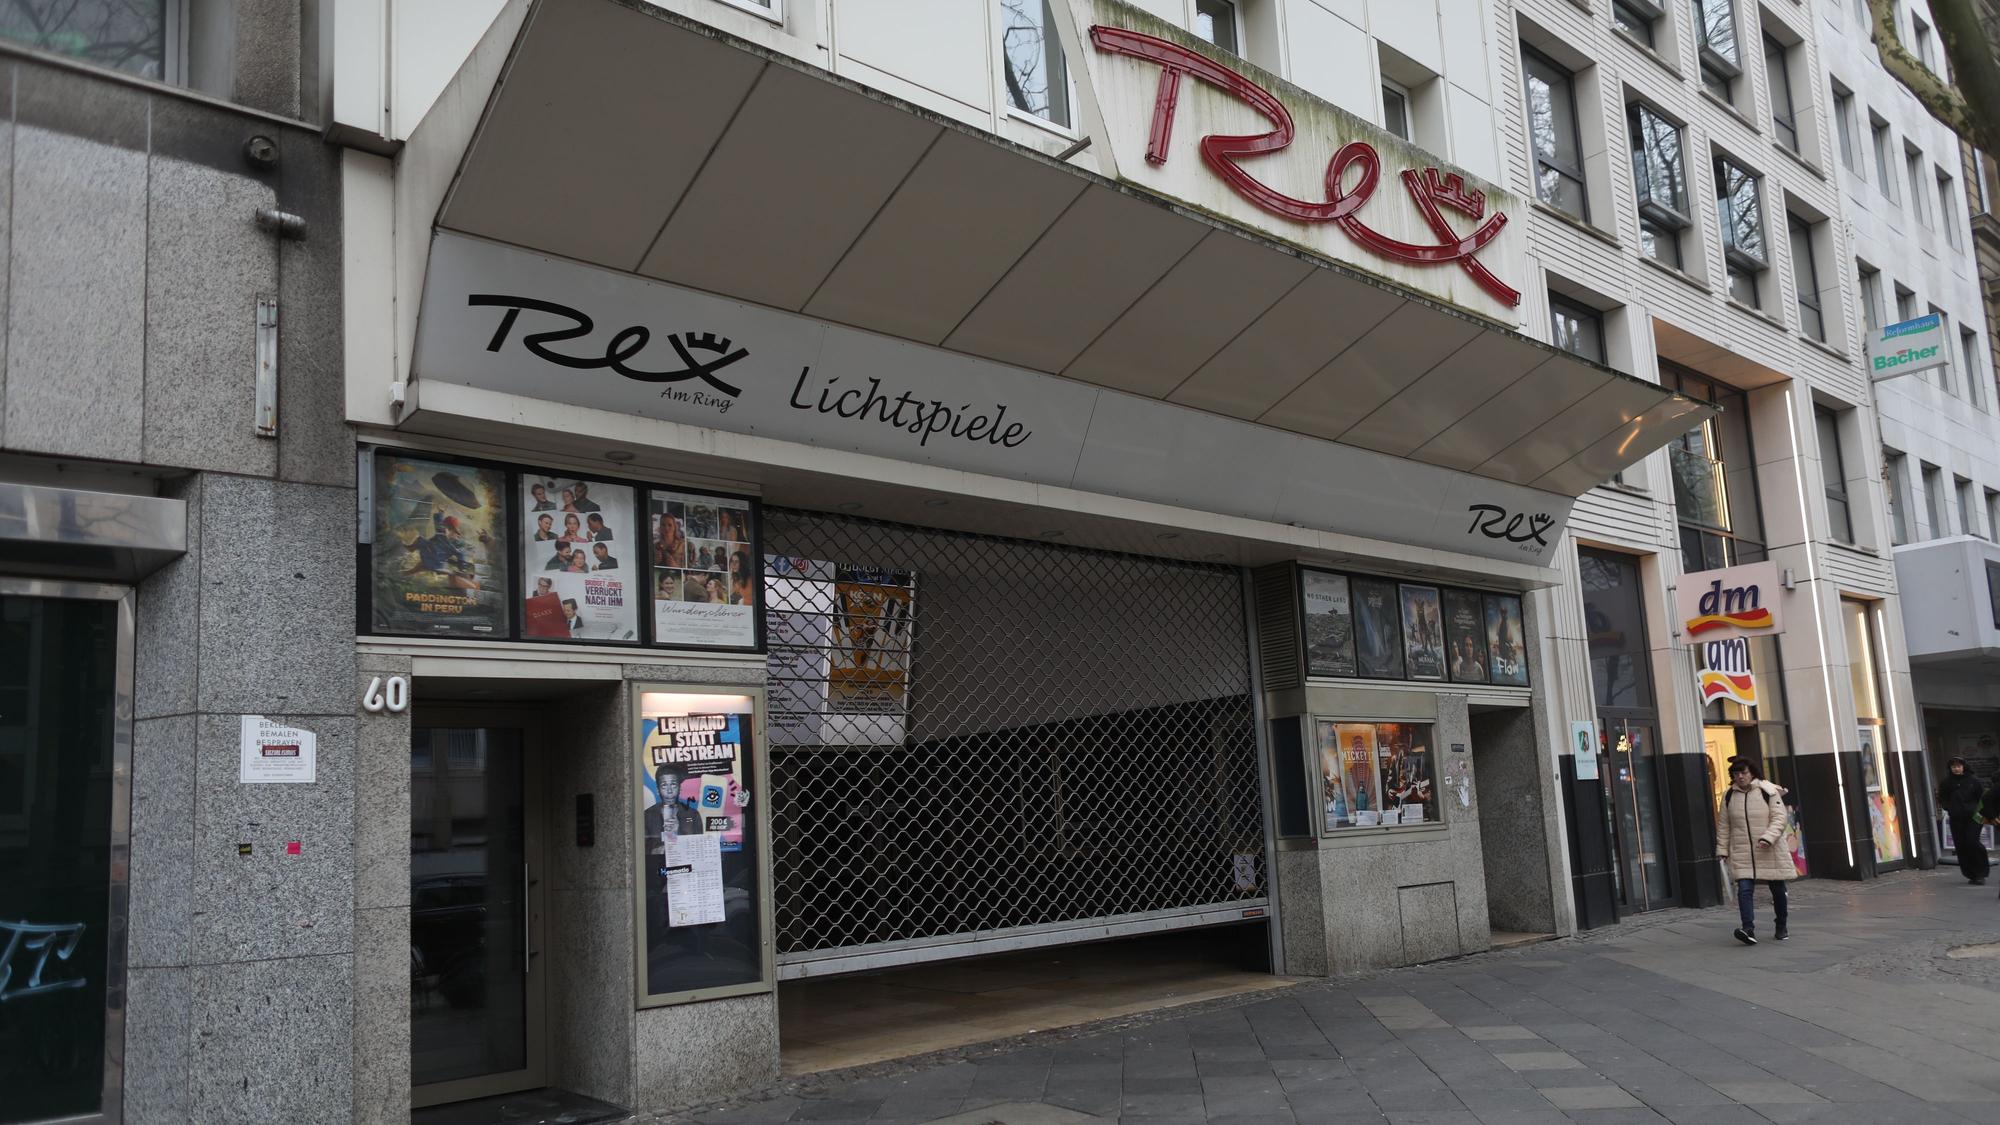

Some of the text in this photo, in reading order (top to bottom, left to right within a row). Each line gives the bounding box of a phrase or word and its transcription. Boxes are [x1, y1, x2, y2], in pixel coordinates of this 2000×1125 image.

[1088, 24, 1521, 307] Rex
[1886, 319, 1935, 337] Reformhaus
[468, 294, 749, 398] Rex
[1873, 345, 1939, 371] Bacher
[661, 387, 734, 414] Am Ring
[789, 366, 1033, 448] Lichtspiele
[1468, 504, 1555, 547] Rex
[421, 603, 463, 614] IN PERU
[585, 596, 623, 607] NACH IHM
[1699, 579, 1759, 616] dm
[363, 676, 408, 712] 60
[660, 716, 726, 733] LEINWAND
[676, 731, 716, 747] STATT
[653, 744, 734, 764] LIVESTREAM
[1341, 750, 1367, 761] MICKEY
[710, 817, 723, 827] 200
